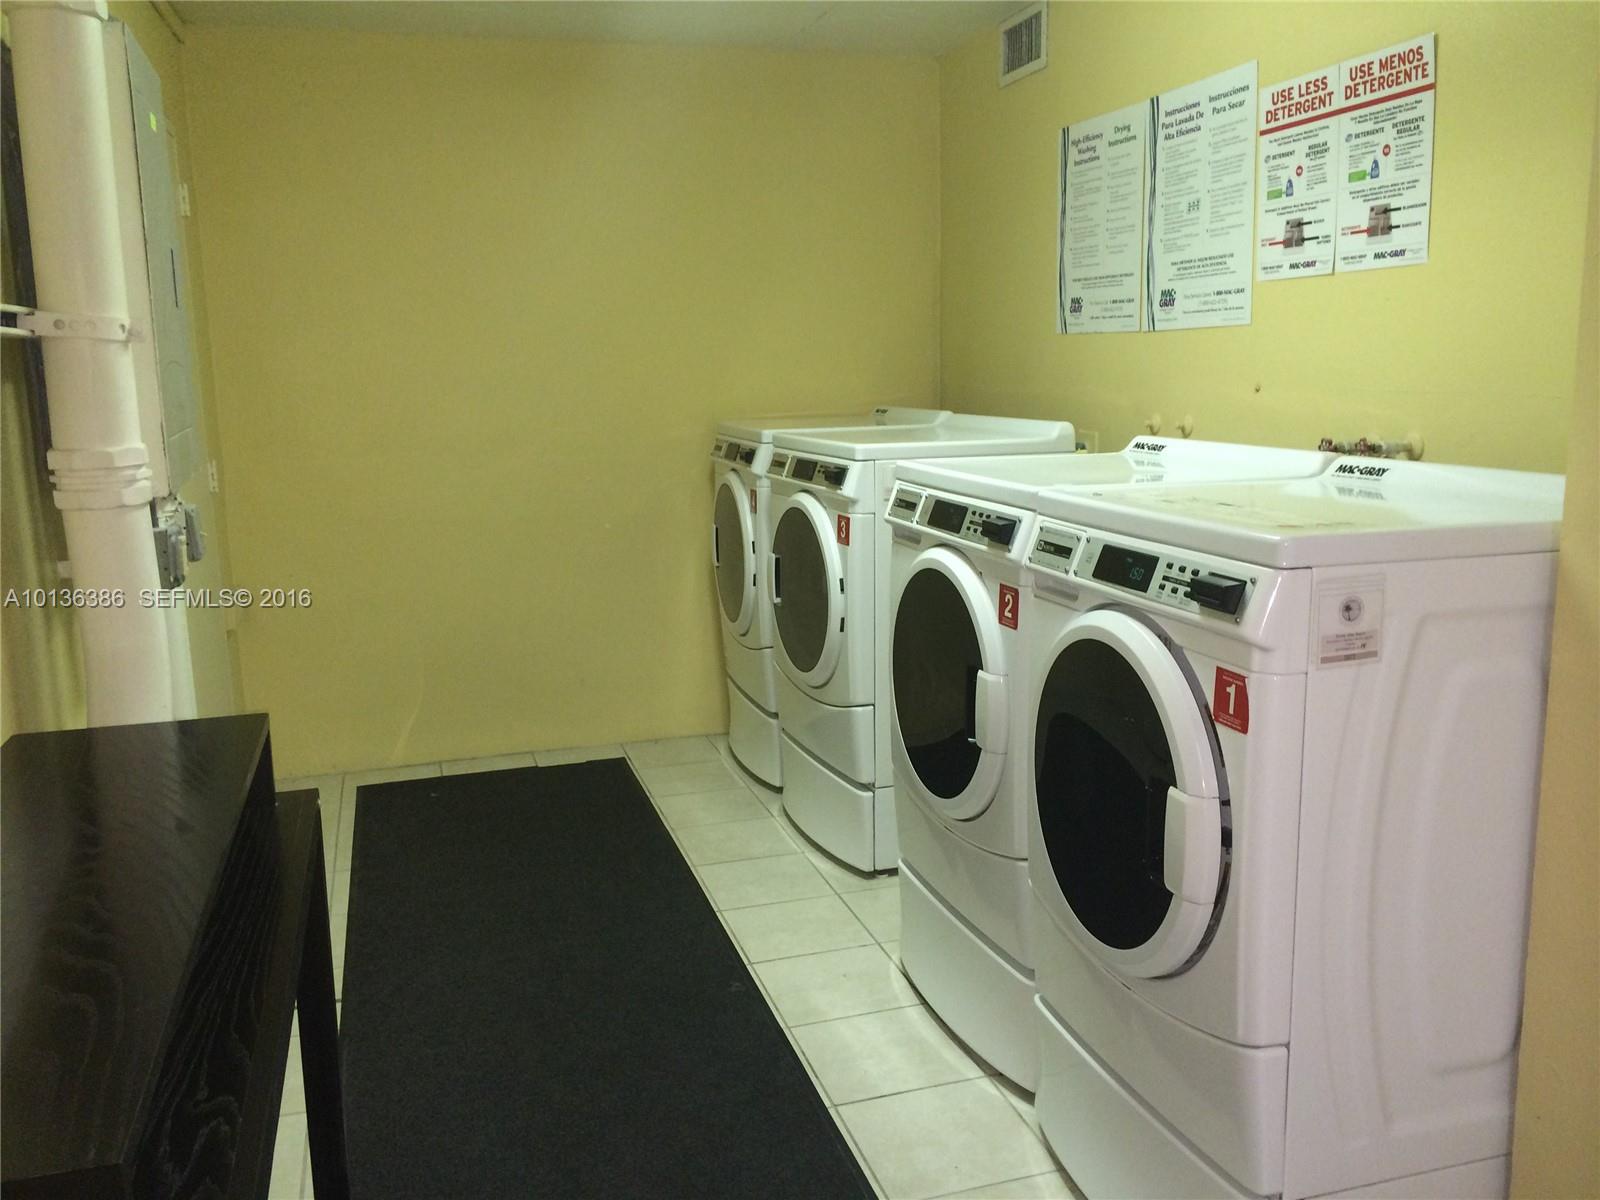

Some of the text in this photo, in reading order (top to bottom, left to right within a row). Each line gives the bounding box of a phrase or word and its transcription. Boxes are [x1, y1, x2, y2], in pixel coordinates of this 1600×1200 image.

[1348, 45, 1424, 82] USE MENOS
[1344, 61, 1429, 101] DETERGENTE
[1208, 84, 1250, 103] Instrucciones
[1271, 75, 1329, 106] USE LESS
[1164, 101, 1201, 118] Instrucciones
[1211, 99, 1247, 116] Para Secar
[1265, 91, 1334, 125] DETERGENT
[1161, 120, 1175, 131] Para
[1195, 110, 1205, 119] De
[1392, 115, 1426, 129] DETERGENTE
[1114, 124, 1132, 135] Drying
[1163, 124, 1202, 142] Alta Eficiencia
[1354, 127, 1386, 140] DETERGENTE
[1396, 124, 1421, 135] REGULAR
[1305, 147, 1331, 159] DETERGENT
[1308, 141, 1328, 151] REGULAR
[1271, 150, 1296, 161] DETERGENT
[1159, 298, 1176, 308] GRAY
[840, 520, 846, 538] 3
[1004, 593, 1013, 619] 2
[1225, 683, 1236, 715] 1
